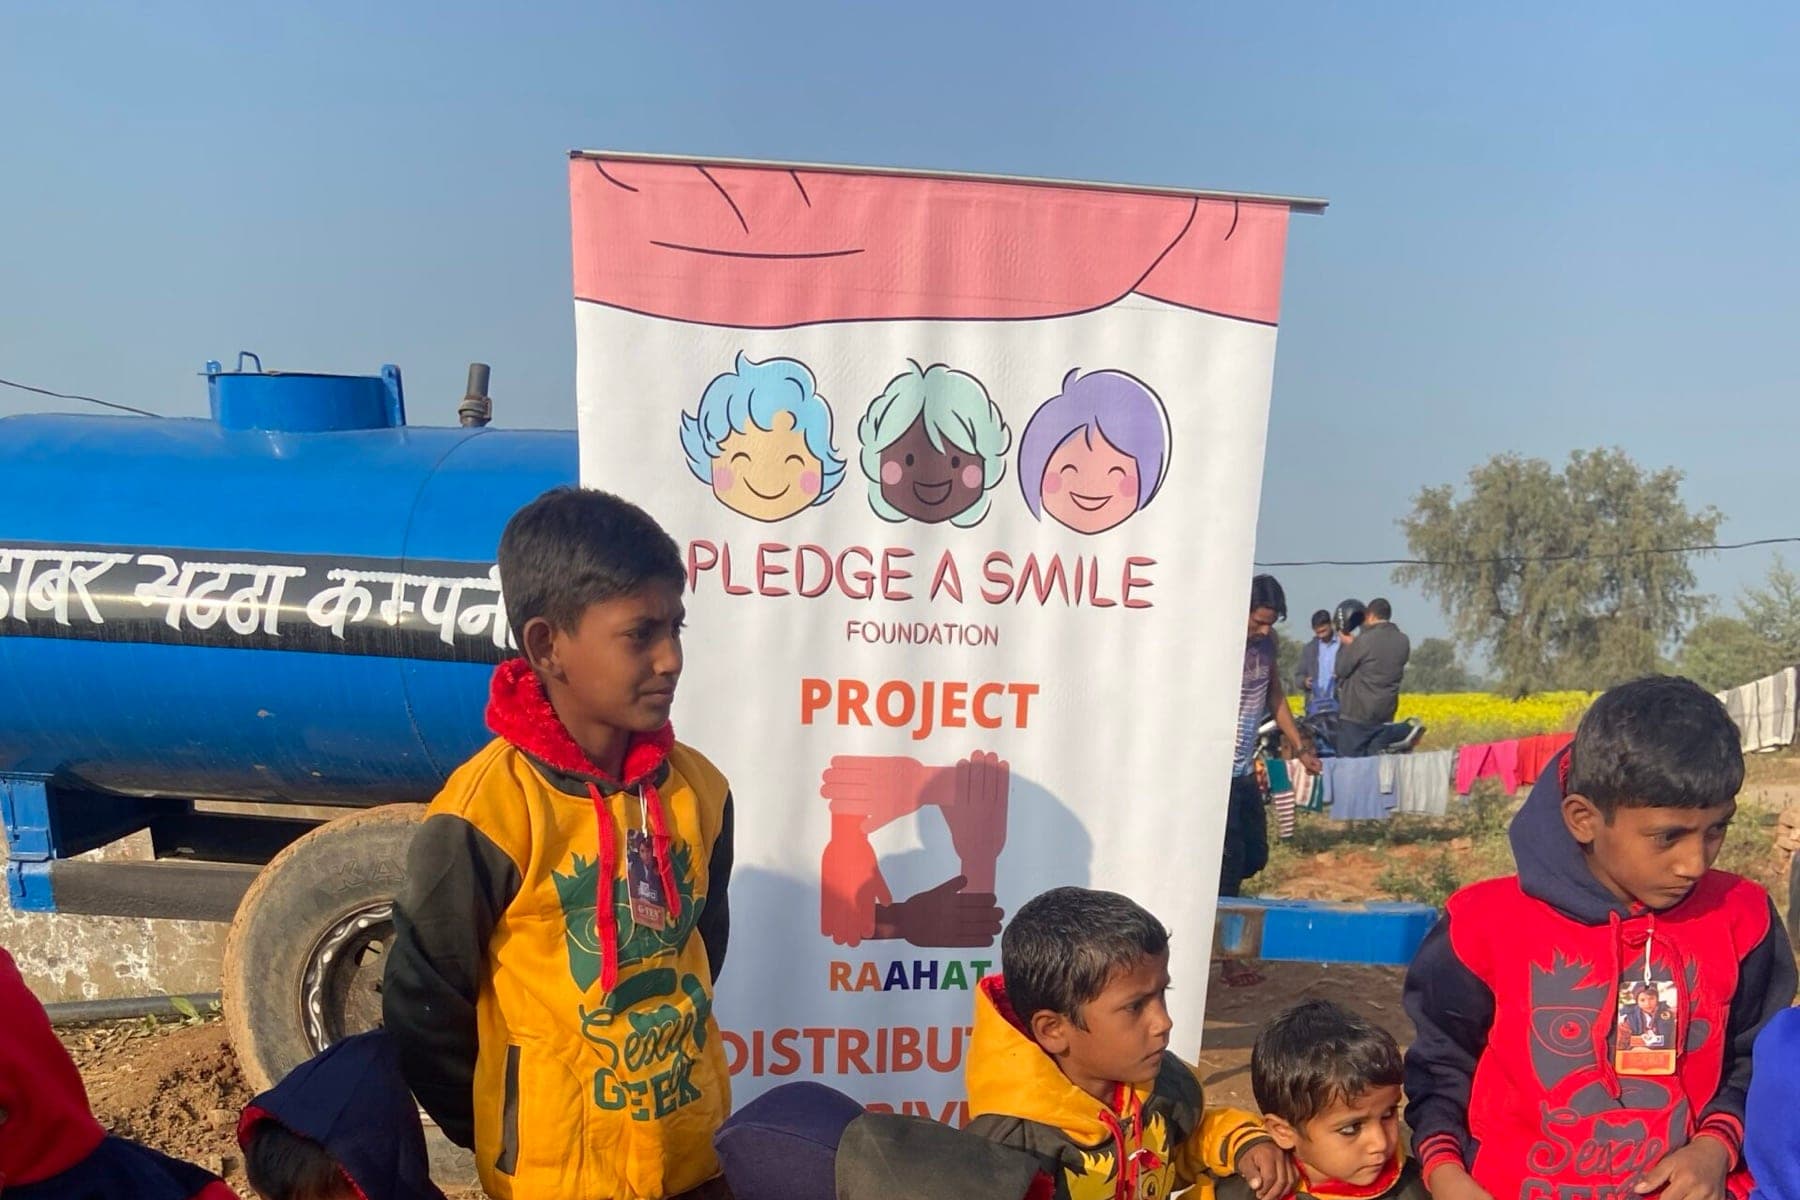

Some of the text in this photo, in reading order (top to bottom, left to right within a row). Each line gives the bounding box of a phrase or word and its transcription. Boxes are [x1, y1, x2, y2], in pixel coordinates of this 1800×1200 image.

[687, 539, 1158, 610] PLEDGE A SMILE
[846, 620, 999, 647] FOUNDATION
[801, 678, 1039, 741] PROJECT
[830, 960, 992, 992] RAAHAT
[720, 1026, 974, 1077] DISTRIBU
[594, 1066, 703, 1121] GEEK
